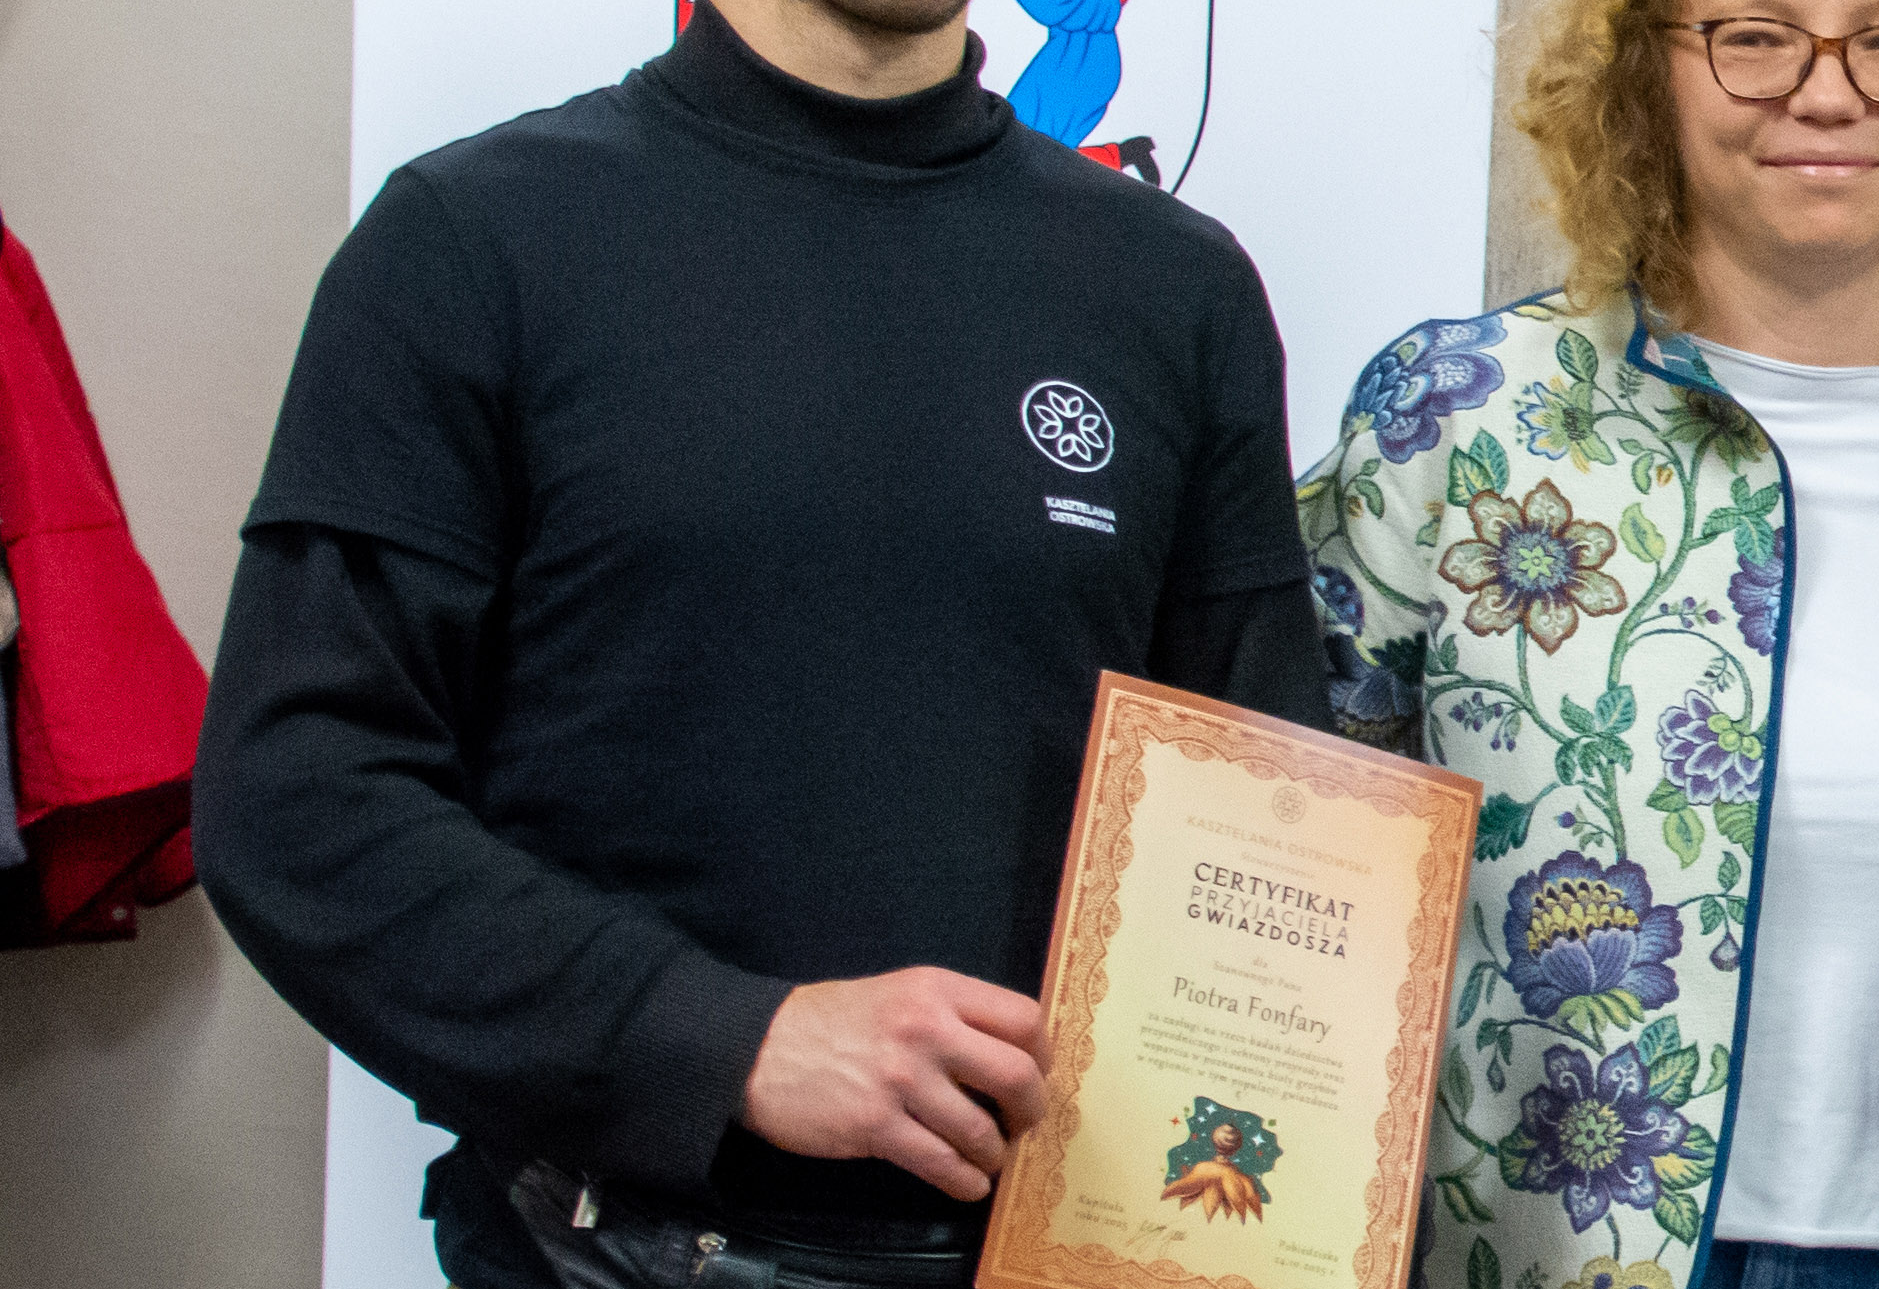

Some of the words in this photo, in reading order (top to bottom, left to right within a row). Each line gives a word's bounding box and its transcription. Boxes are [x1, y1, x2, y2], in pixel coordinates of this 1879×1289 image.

[1187, 815, 1282, 850] KASZTELANIA
[1288, 843, 1373, 875] OSTROWSKA
[1190, 885, 1349, 943] PRZYJACIELA
[1193, 860, 1354, 922] CERTYFIKAT
[1186, 903, 1346, 958] GWIAZDOSZA
[1171, 975, 1240, 1014] Piotra
[1245, 993, 1332, 1044] Fonfary
[1140, 1023, 1220, 1054] przyrodniczego
[1231, 1046, 1271, 1066] ochrony
[1274, 1058, 1319, 1079] przyrody
[1220, 1031, 1245, 1043] rzecz
[1284, 1042, 1343, 1067] dziedzictwa
[1296, 1076, 1337, 1098] grzybów
[1075, 1209, 1099, 1222] roku
